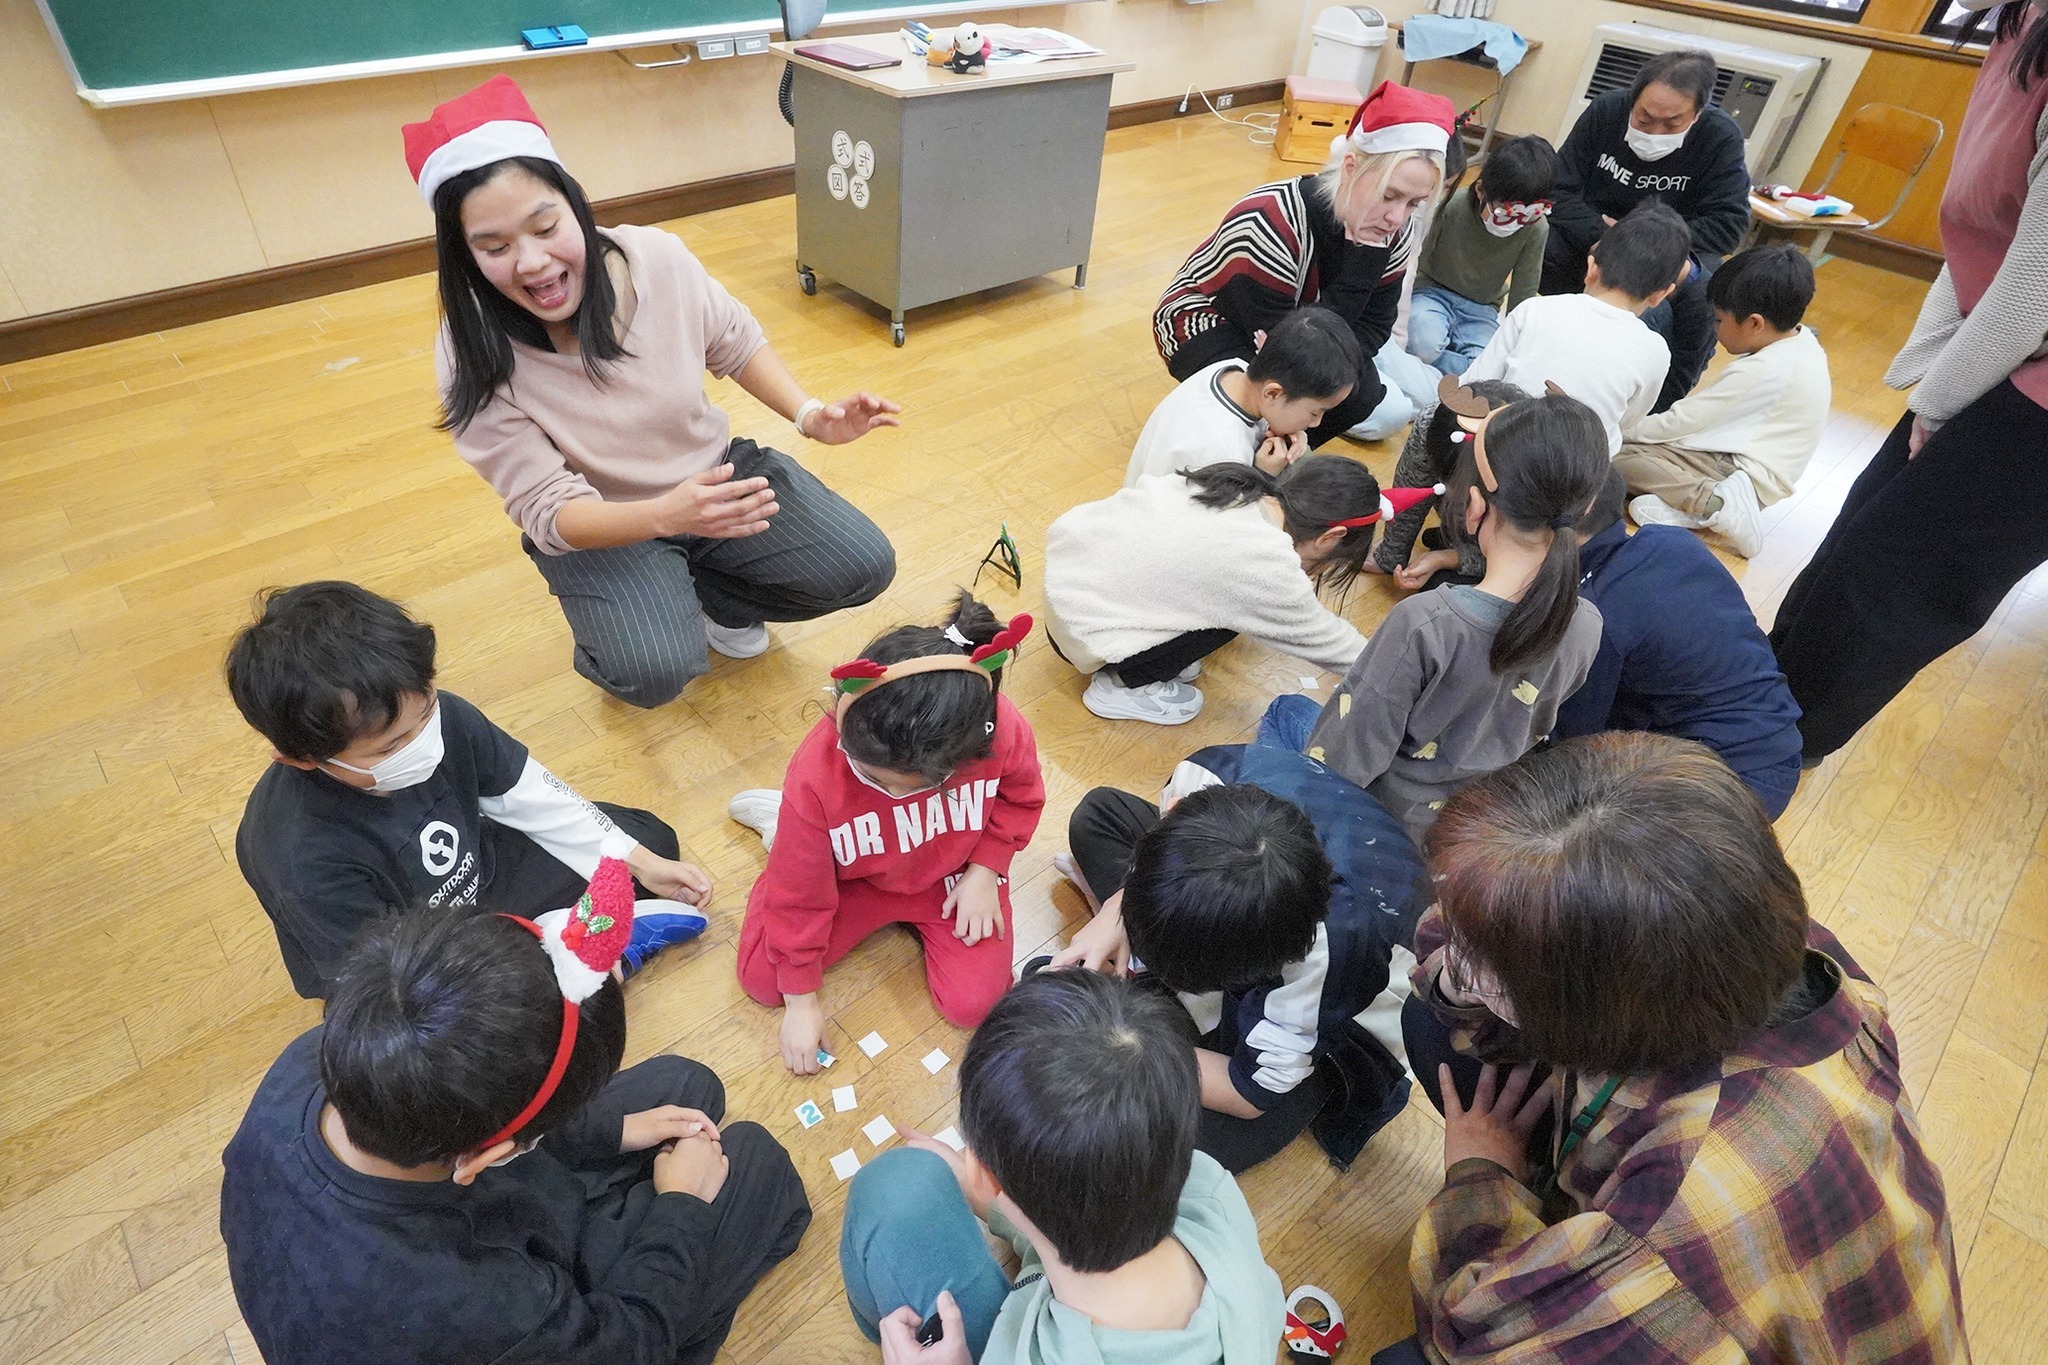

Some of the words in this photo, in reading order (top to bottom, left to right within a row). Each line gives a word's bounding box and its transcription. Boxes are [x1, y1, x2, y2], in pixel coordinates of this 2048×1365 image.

[1635, 175, 1691, 192] SPORT
[428, 851, 475, 909] OUTDOOR
[801, 1104, 821, 1125] 2
